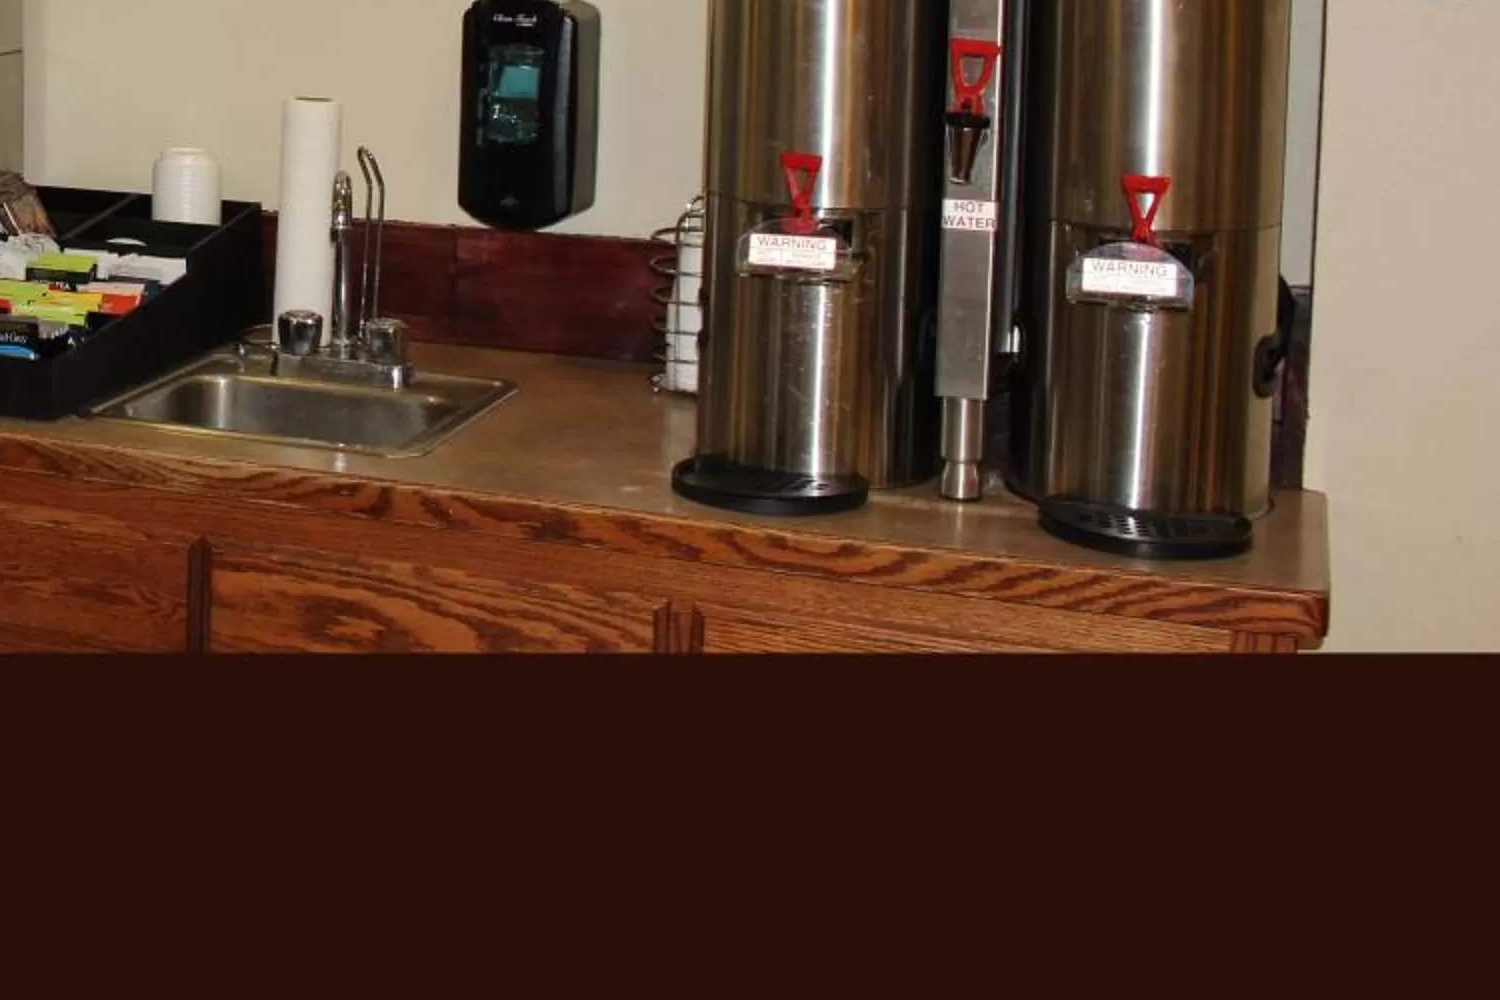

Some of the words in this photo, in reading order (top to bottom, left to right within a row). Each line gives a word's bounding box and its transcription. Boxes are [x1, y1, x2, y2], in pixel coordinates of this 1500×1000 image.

[954, 201, 985, 213] HOT
[942, 216, 997, 229] WATER
[756, 236, 827, 250] WARNING
[1091, 260, 1169, 277] WARNING
